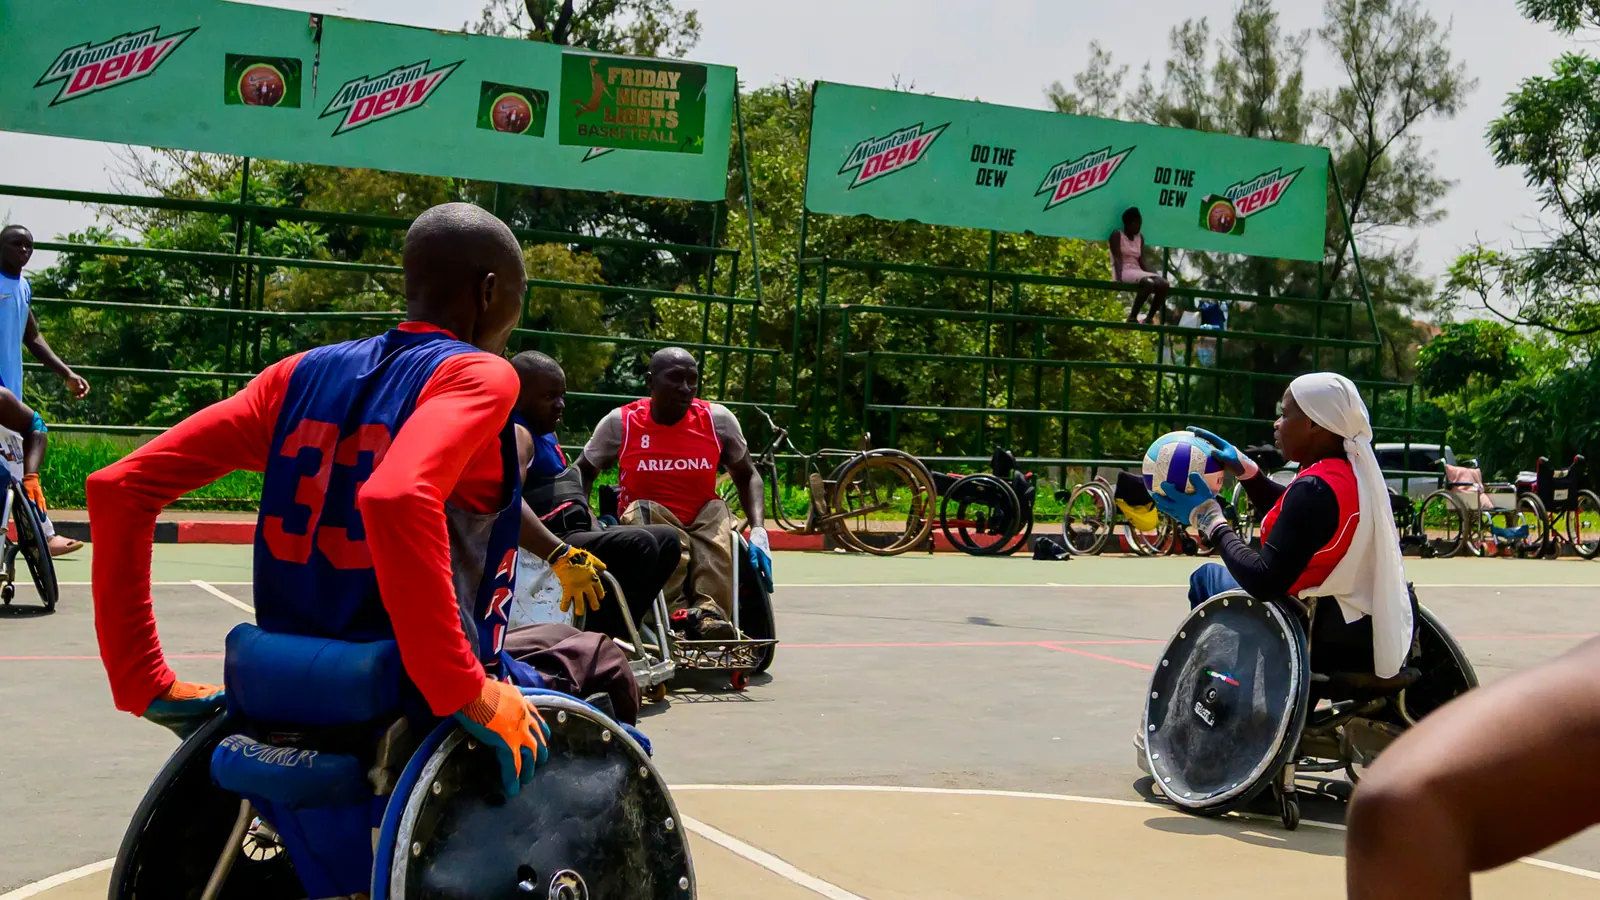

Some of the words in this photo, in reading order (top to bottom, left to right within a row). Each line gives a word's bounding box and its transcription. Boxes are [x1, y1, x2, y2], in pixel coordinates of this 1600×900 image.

[51, 34, 149, 75] Mountain
[334, 67, 422, 107] Mountain
[608, 66, 681, 89] FRIDAY
[616, 87, 680, 109] NIGHT
[604, 105, 679, 129] LIGHTS
[578, 124, 678, 143] BASKETBALL
[849, 129, 918, 164] Mountain
[970, 144, 990, 163] DO
[993, 147, 1016, 166] THE
[975, 168, 1008, 188] DEW
[1044, 152, 1105, 185] Mountain
[1154, 166, 1170, 185] DO
[1174, 169, 1196, 187] THE
[1158, 189, 1188, 208] DEW
[640, 434, 650, 449] 8
[636, 457, 710, 472] ARIZONA
